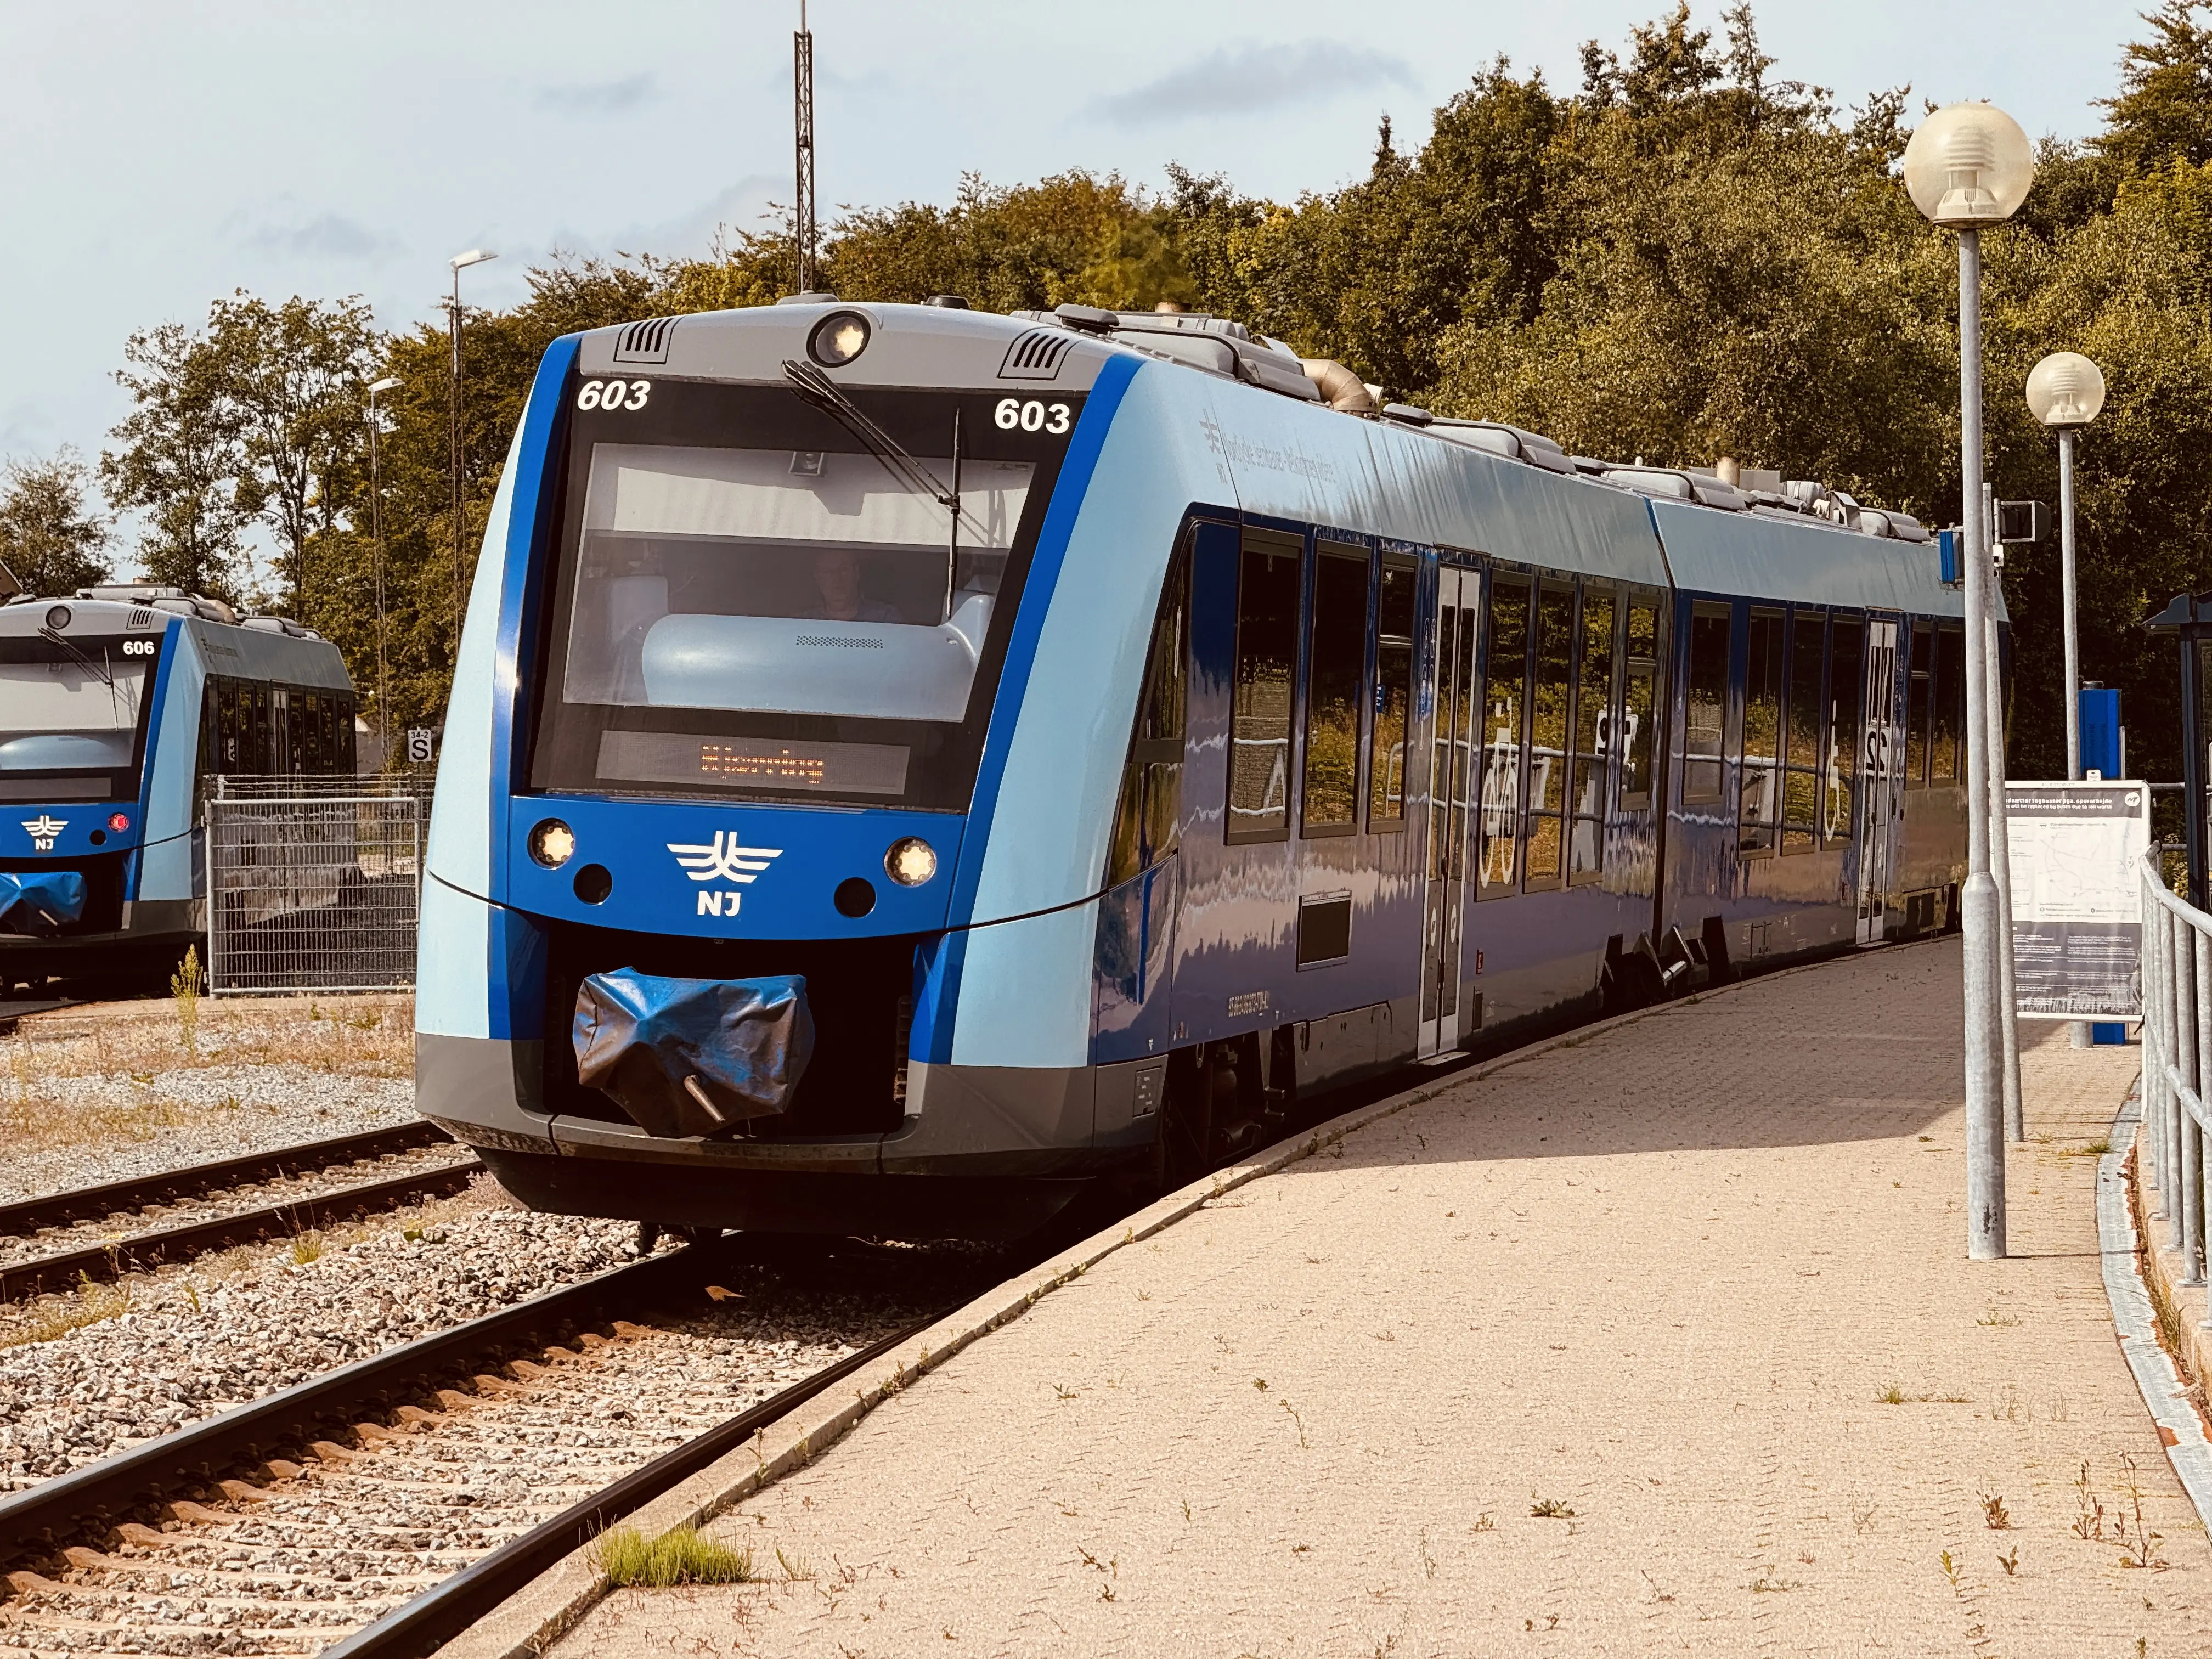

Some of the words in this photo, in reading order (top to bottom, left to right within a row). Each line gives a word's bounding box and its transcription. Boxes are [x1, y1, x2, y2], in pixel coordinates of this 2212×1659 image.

[577, 380, 651, 410] 603
[995, 398, 1070, 434] 603
[123, 641, 155, 655] 606
[411, 731, 428, 739] 34-2
[411, 739, 428, 760] S
[35, 838, 54, 850] NJ
[697, 890, 741, 917] NJ
